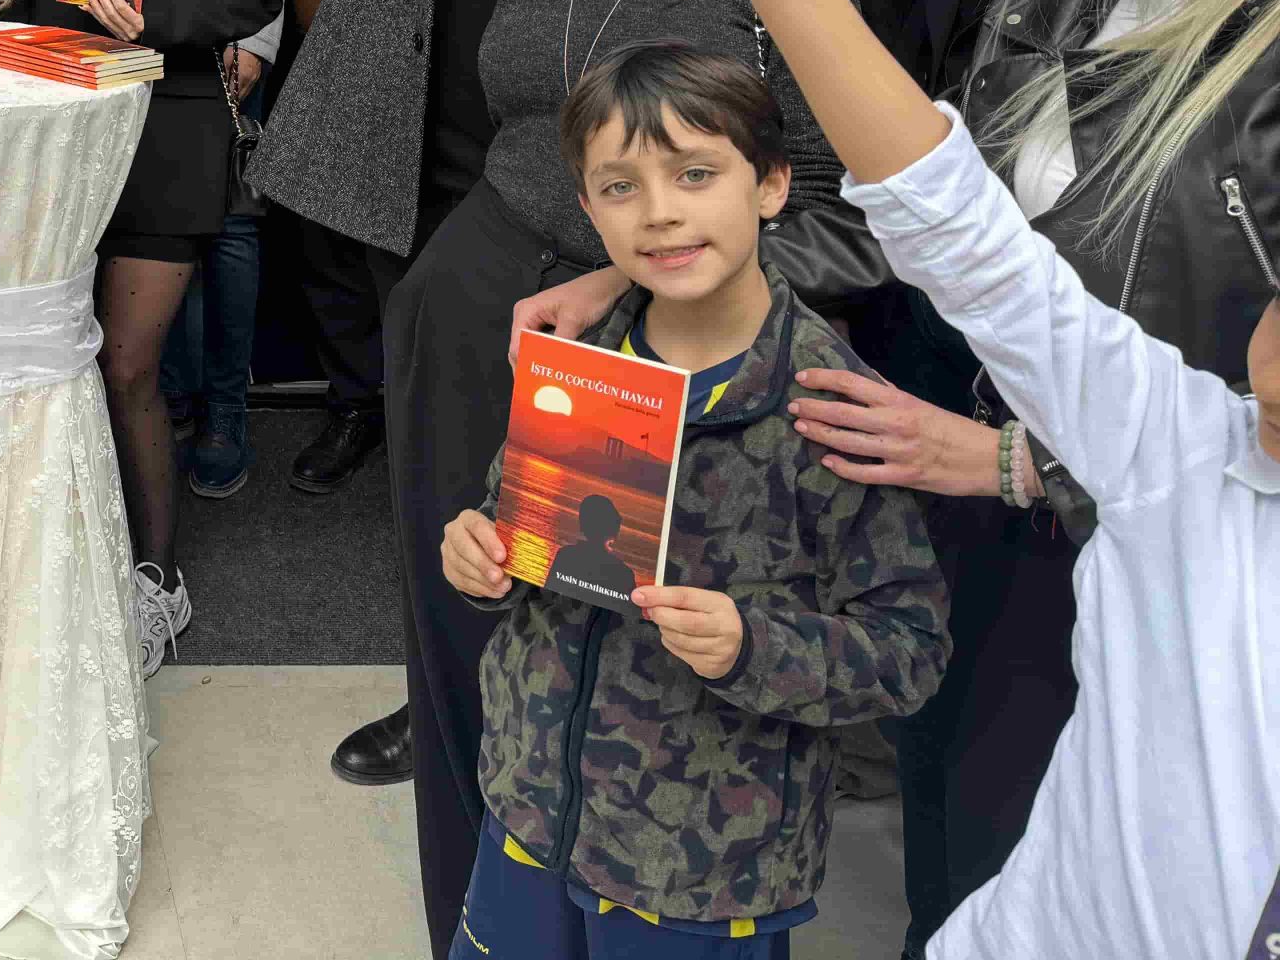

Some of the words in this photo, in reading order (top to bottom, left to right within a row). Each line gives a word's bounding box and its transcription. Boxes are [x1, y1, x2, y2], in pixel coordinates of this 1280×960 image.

[530, 361, 552, 379] İŞTE
[556, 371, 563, 381] O
[565, 373, 619, 398] ÇOCUĞUN
[621, 389, 663, 410] HAYALİ
[556, 571, 577, 588] YASİN
[579, 578, 630, 601] DEMİRKIRAN
